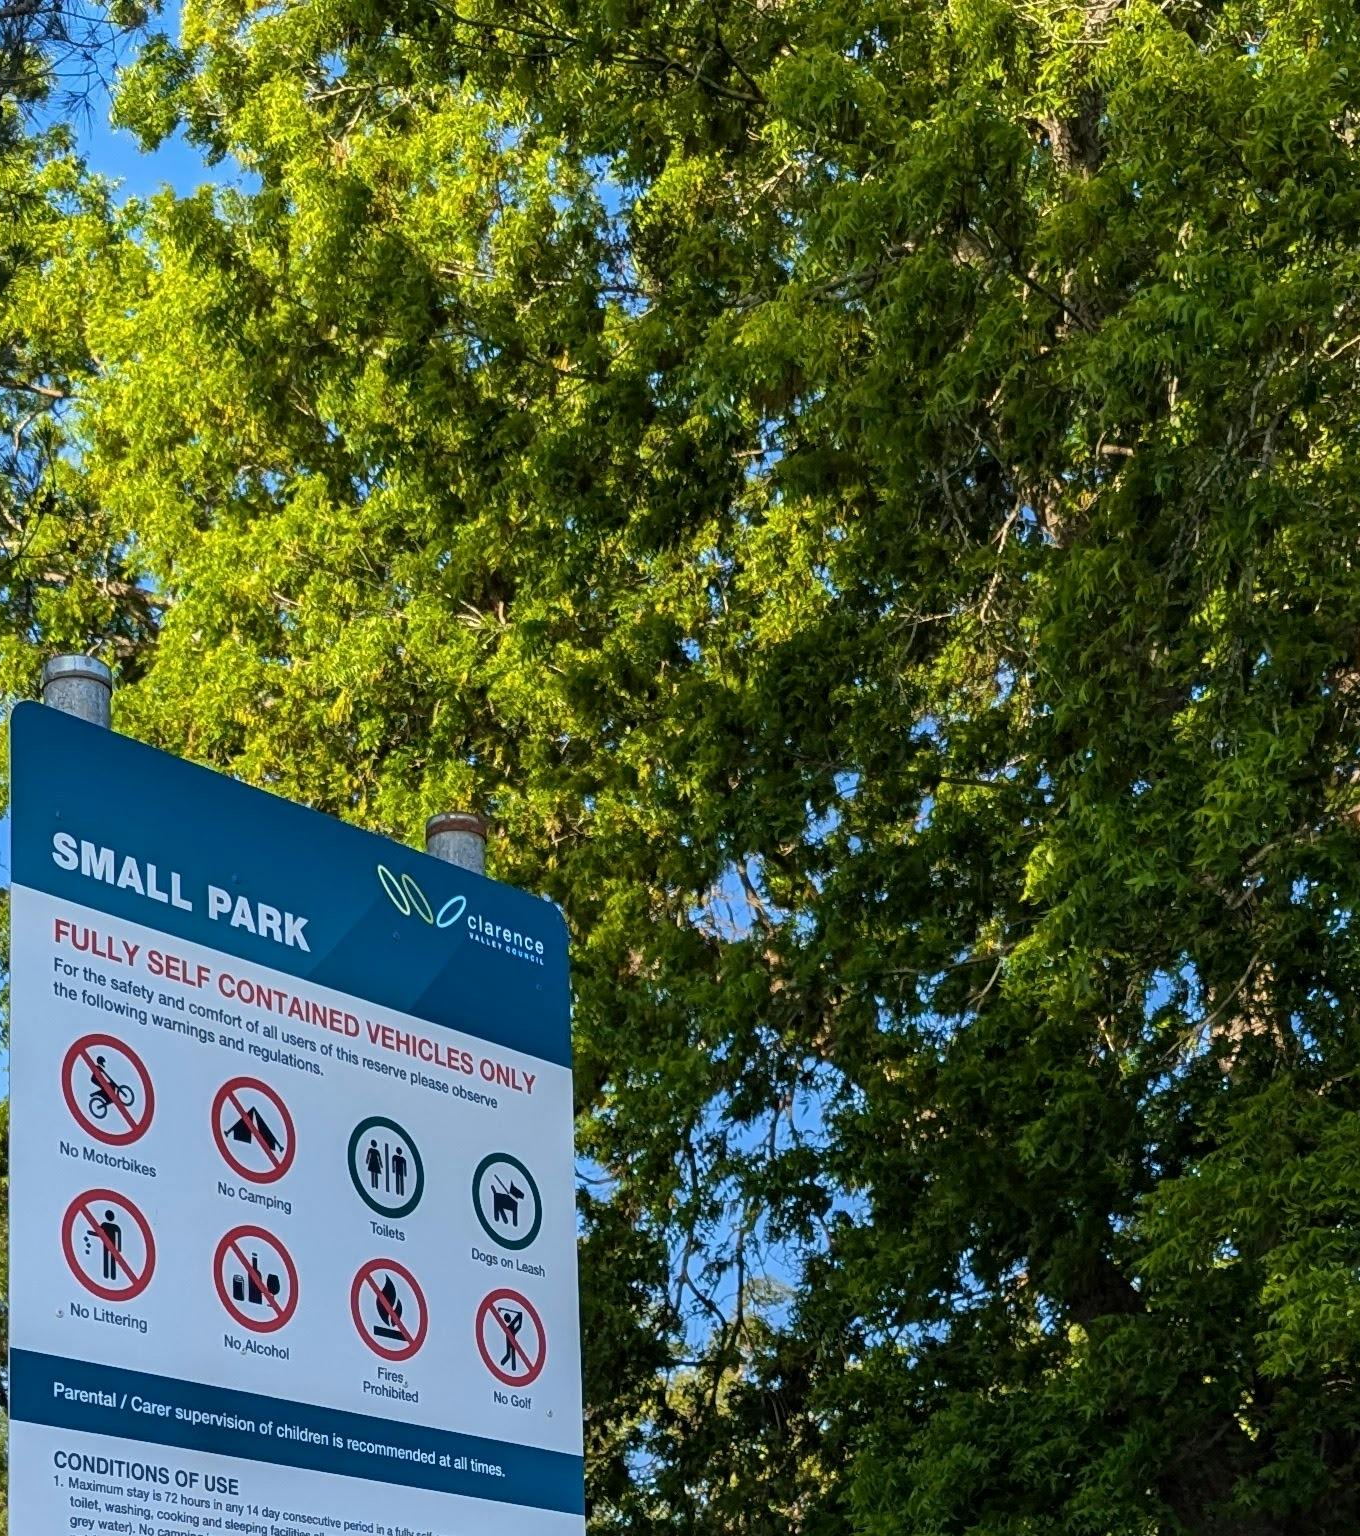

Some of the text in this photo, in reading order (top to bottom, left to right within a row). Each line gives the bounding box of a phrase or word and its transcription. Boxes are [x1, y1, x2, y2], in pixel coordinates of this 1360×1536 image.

[51, 832, 311, 953] SMALL PARK
[467, 914, 544, 955] clarence
[54, 918, 536, 1095] FULLY SELF CONTAINED VEHICLES ONLY
[53, 981, 324, 1076] the following warnings and regulations.
[54, 956, 498, 1109] For the safety and comfort of all users of this reserve please observe
[59, 1140, 157, 1178] No Motorbikes
[217, 1181, 292, 1215] No Camping
[369, 1220, 406, 1242] Toilets
[471, 1247, 546, 1278] Dogs on Leash
[70, 1302, 148, 1334] No Littering
[224, 1334, 289, 1360] No Alcohol
[363, 1380, 419, 1403] Prohibited
[377, 1366, 403, 1384] Fires
[493, 1390, 532, 1410] No Golf
[53, 1381, 506, 1478] Parental / Carer supervision of children is recommended at all times.
[53, 1450, 239, 1496] CONDITIONS OF USE
[53, 1474, 244, 1517] 1. Maximum stay is 72 hours in any
